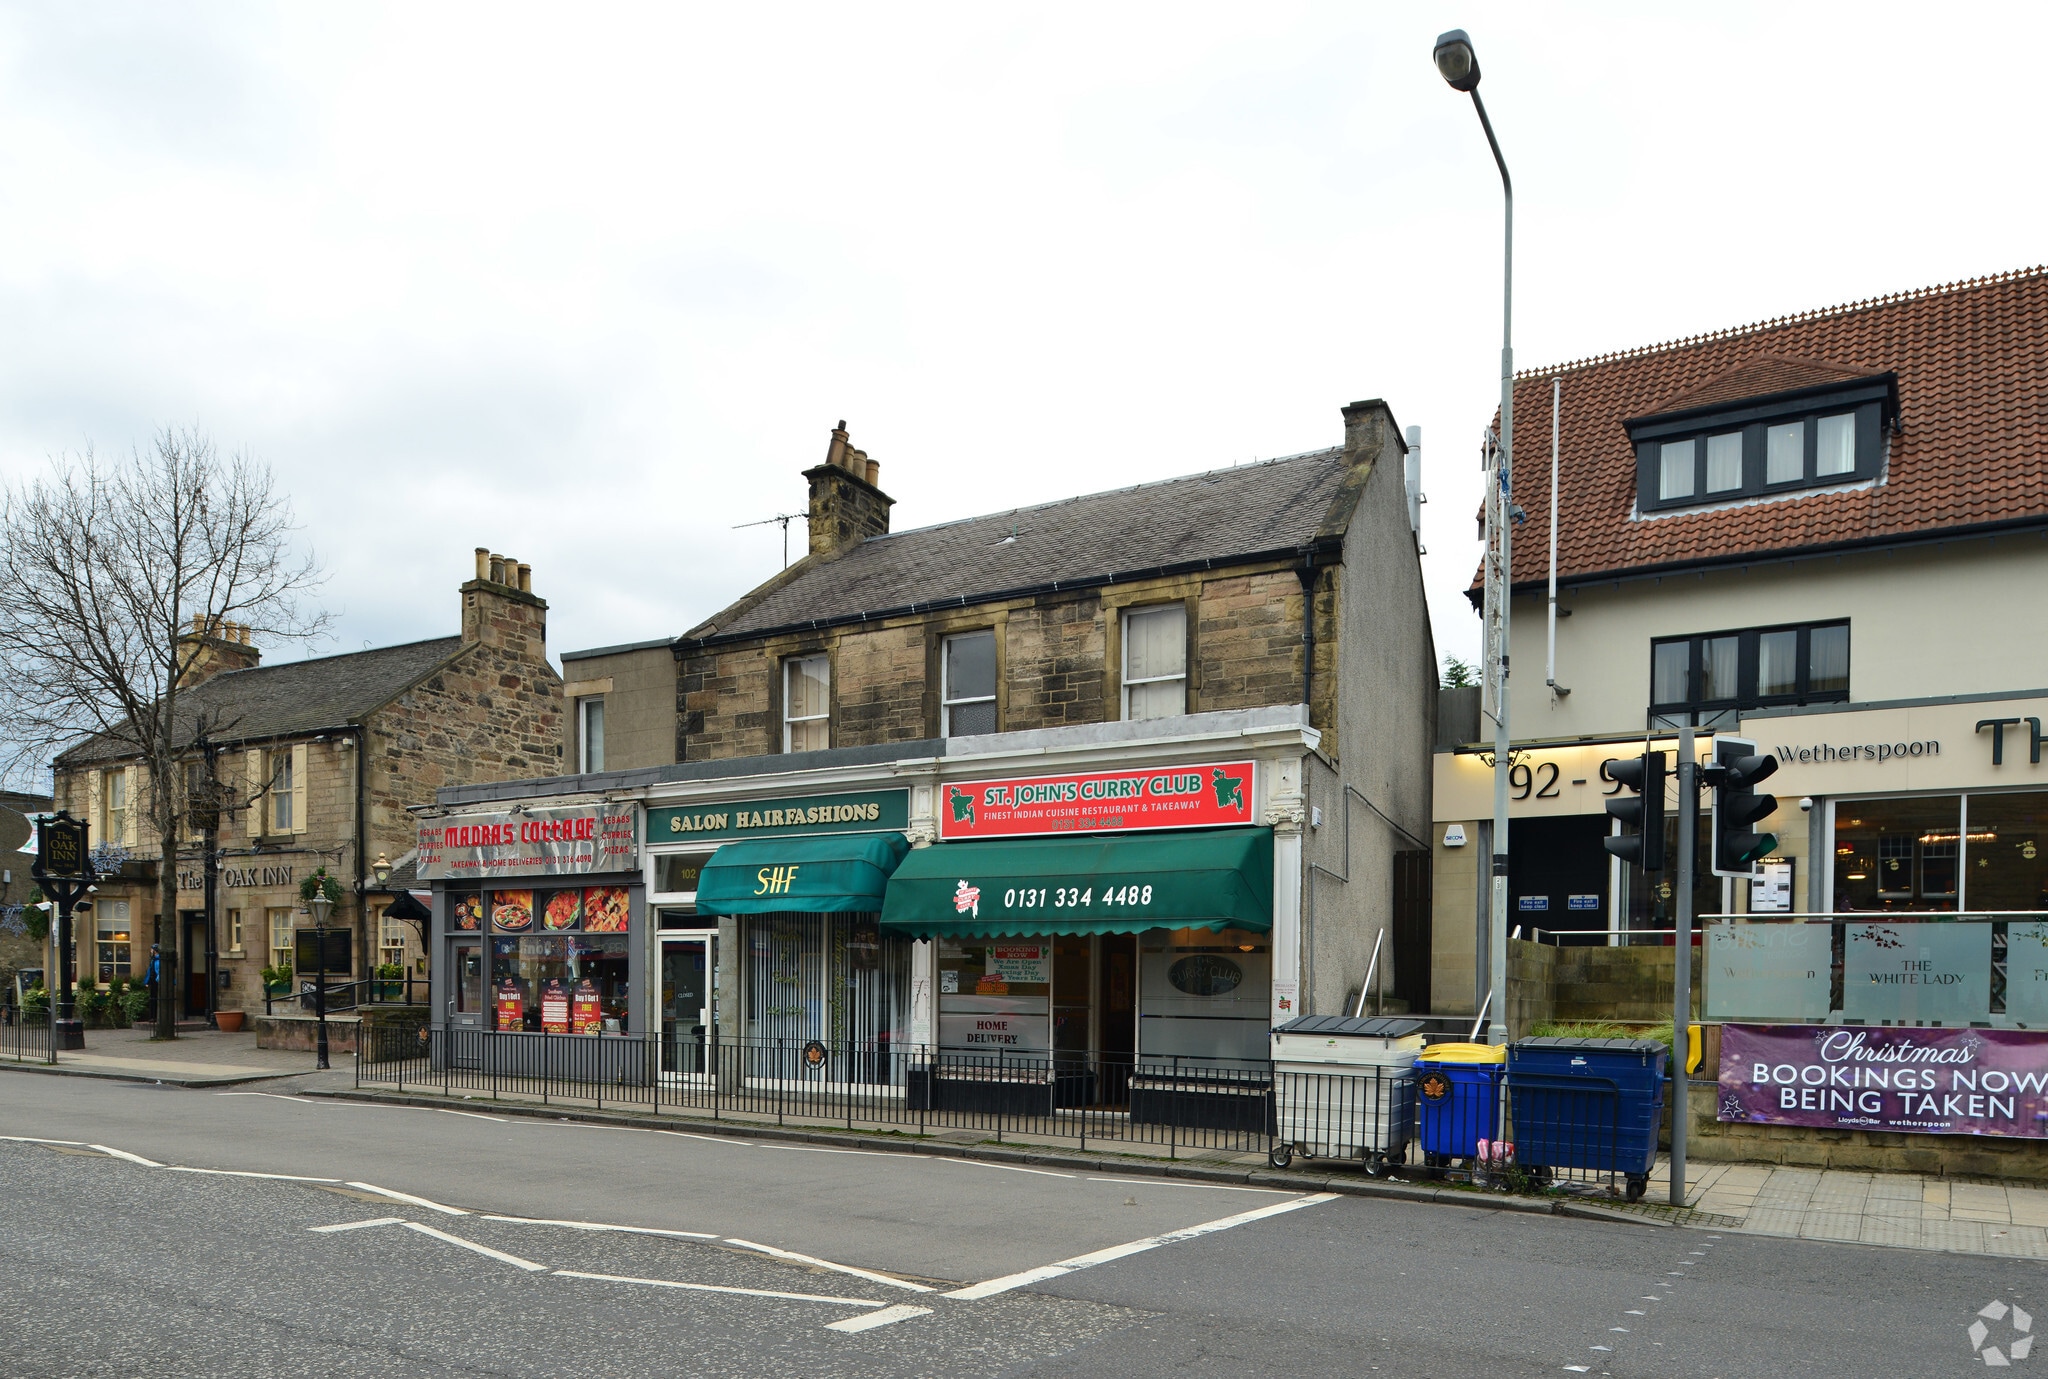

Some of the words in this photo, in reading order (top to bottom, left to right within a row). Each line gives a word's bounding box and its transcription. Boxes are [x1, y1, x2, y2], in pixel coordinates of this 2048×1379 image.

[1776, 738, 1940, 766] Wetherspoon
[1080, 776, 1150, 801] CURRY
[1149, 774, 1202, 795] CLUB
[1508, 762, 1560, 801] 92
[670, 813, 728, 832] SALON
[736, 802, 880, 829] HAIRFASHIONS
[984, 812, 1012, 820] FINEST
[1014, 810, 1044, 818] INDIAN
[1046, 808, 1080, 818] CUISINE
[1082, 804, 1139, 814] RESTAURANT
[1142, 804, 1148, 812] &
[1151, 800, 1200, 812] TAKEAWAY
[603, 815, 630, 825] KEBABS
[1052, 819, 1075, 830] 0131
[1078, 818, 1096, 829] 334
[1099, 816, 1124, 828] 4488
[56, 832, 72, 840] The
[444, 822, 514, 848] MADRAS
[602, 830, 632, 840] CURRIES
[50, 840, 78, 850] OAK
[418, 841, 444, 850] CURRIES
[604, 845, 629, 854] PIZZAS
[52, 850, 76, 860] INN
[450, 858, 481, 868] TAKEAWAY
[488, 858, 506, 867] HOME
[508, 856, 542, 866] DELIVERIES
[545, 856, 560, 865] 0131
[178, 870, 202, 890] The
[224, 868, 258, 888] OAK
[261, 866, 292, 886] INN
[681, 868, 696, 880] 102
[1004, 888, 1046, 908] 0131
[1054, 886, 1092, 906] 334
[1102, 884, 1152, 906] 4488
[1901, 960, 1932, 972] THE
[1210, 966, 1241, 984] CLUB
[1869, 972, 1920, 986] WHITE
[1923, 972, 1966, 986] LADY
[976, 1021, 1007, 1030] HOME
[967, 1033, 1018, 1044] DELIVERY
[1820, 1030, 1975, 1064] Christmas
[1752, 1063, 1936, 1090] BOOKINGS
[1952, 1069, 2048, 1094] NOW
[1780, 1088, 1882, 1113] BEING
[1896, 1092, 2015, 1118] TAKEN
[1889, 1120, 1951, 1128] wetherspoon
